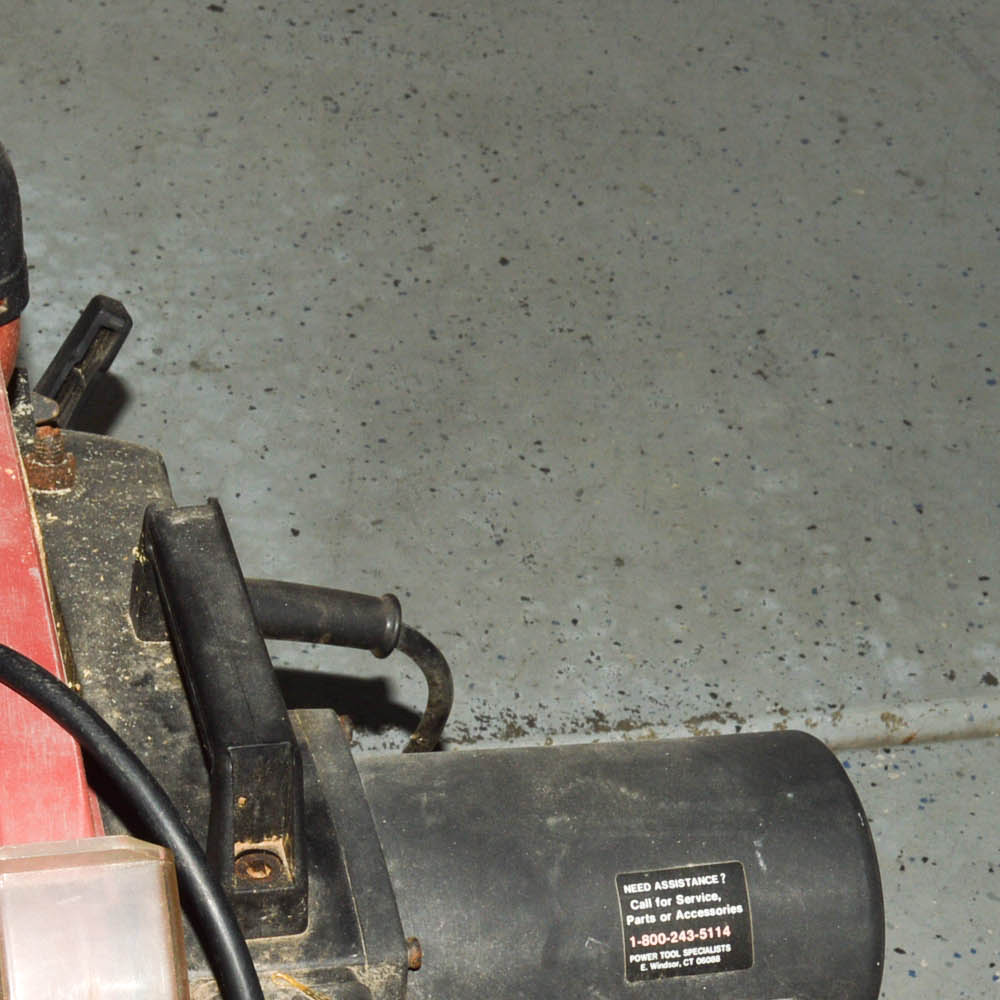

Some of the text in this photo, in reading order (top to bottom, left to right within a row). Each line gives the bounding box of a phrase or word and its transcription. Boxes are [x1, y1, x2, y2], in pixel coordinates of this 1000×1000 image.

[623, 882, 651, 894] NEED
[630, 891, 721, 910] Call for Service,
[626, 903, 743, 926] Parts or Accessories
[629, 925, 731, 948] 1-800-243-5114
[629, 944, 732, 963] POWER TOOL SPECIALISTS
[683, 958, 694, 966] CT
